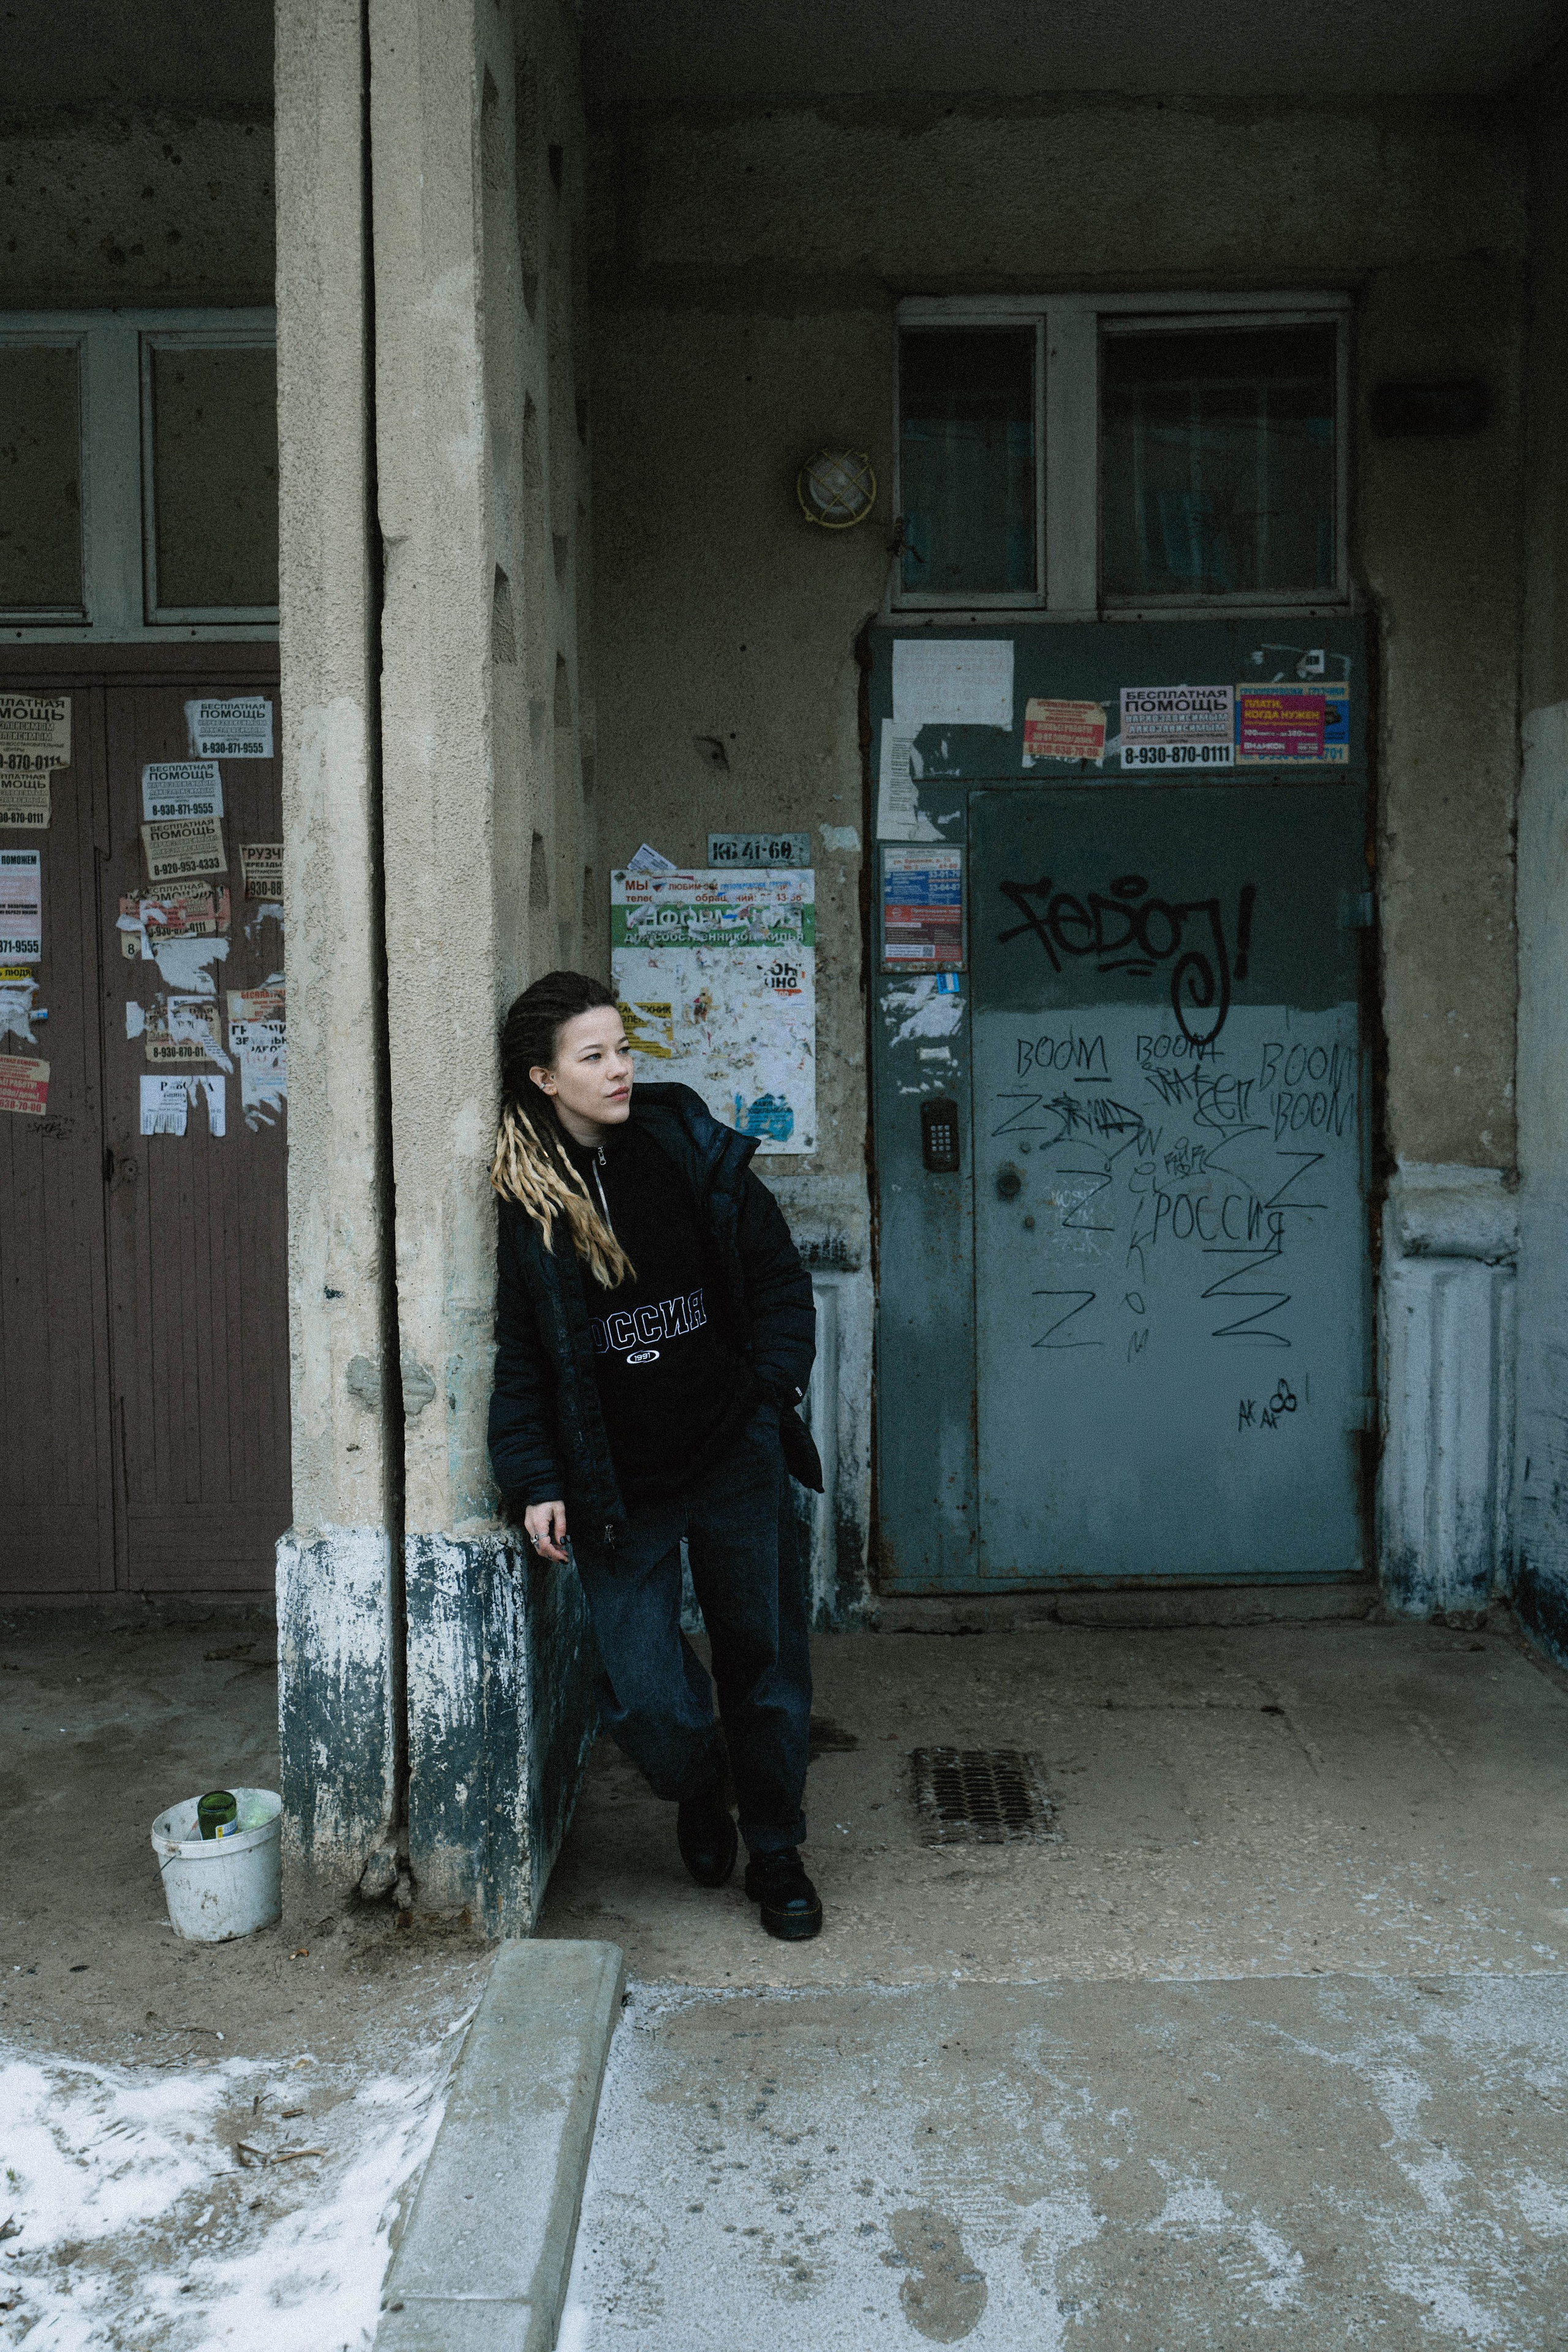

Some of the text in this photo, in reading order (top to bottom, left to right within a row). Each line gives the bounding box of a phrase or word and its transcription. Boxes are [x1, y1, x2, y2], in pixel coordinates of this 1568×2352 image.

[1126, 690, 1227, 699] БЕСПЛАТНАЯ
[1125, 699, 1227, 712] ПОМОЩЬ
[200, 710, 266, 720] ПОМОЩЬ
[1245, 710, 1320, 720] КОГДА НУЖЕН
[202, 742, 264, 753] 8-930-871-9555
[1125, 745, 1229, 764] 8-930-870-0111
[149, 764, 214, 772] БЕСПЛАТНАЯ
[149, 771, 214, 781] ПОМОЩЬ
[1, 780, 47, 790] МОЩЬ
[152, 802, 214, 816] 8-930-871-9555
[150, 819, 214, 832] БЕСПЛАТНАЯ
[150, 826, 216, 841] ПОМОЩЬ
[1, 855, 37, 864] ПОМОЖЕМ
[154, 858, 220, 876] 8-920-953-4333
[625, 880, 648, 891] МЫ
[1153, 1193, 1285, 1254] РОССИЯ
[633, 1352, 651, 1362] 1991
